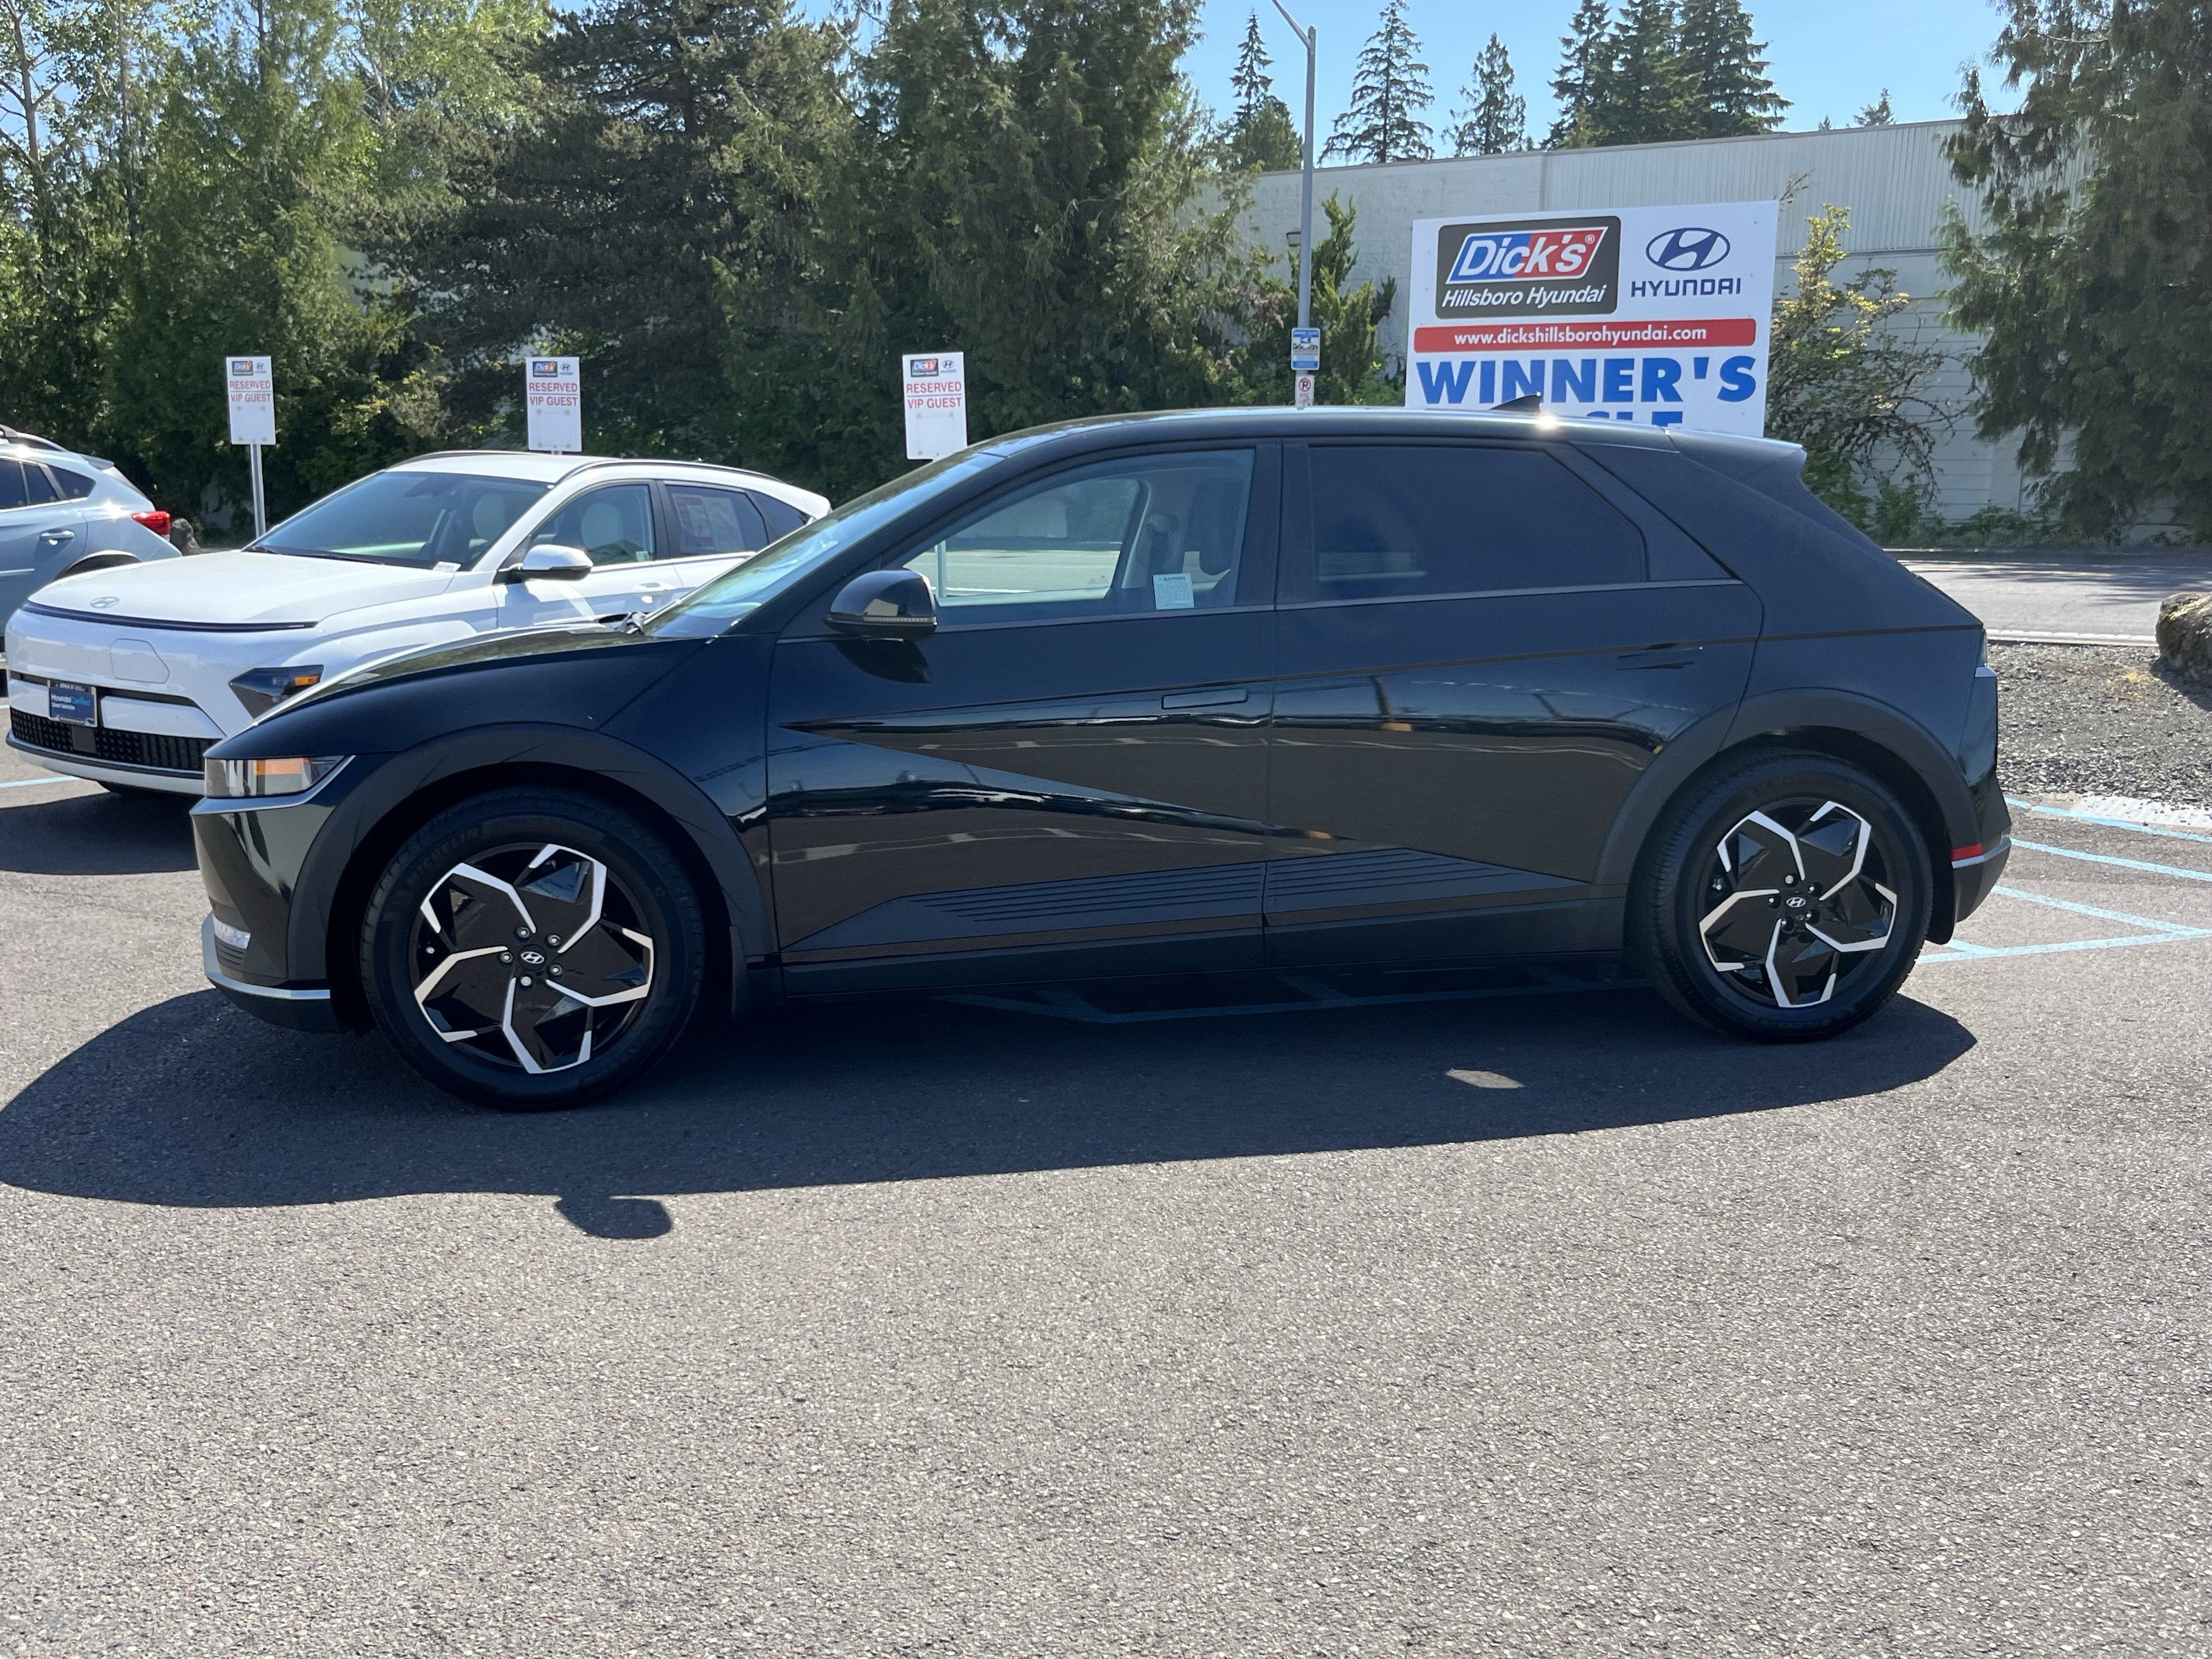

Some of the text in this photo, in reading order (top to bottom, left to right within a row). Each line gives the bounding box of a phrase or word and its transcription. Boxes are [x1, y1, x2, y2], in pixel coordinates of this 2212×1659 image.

[1458, 234, 1586, 276] Dick's
[1630, 278, 1741, 297] HYUNDAI
[1442, 285, 1607, 308] Hillsboro Hyundai
[1454, 325, 1707, 346] www.dickshillsborohyundai.com
[229, 380, 270, 390] RESERVED
[1416, 356, 1757, 404] WINNER'S
[529, 382, 578, 392] RESERVED
[906, 381, 962, 393] RESERVED
[230, 393, 271, 402] VIP GUEST
[529, 396, 578, 406] VIP GUEST
[907, 397, 962, 409] VIP GUEST
